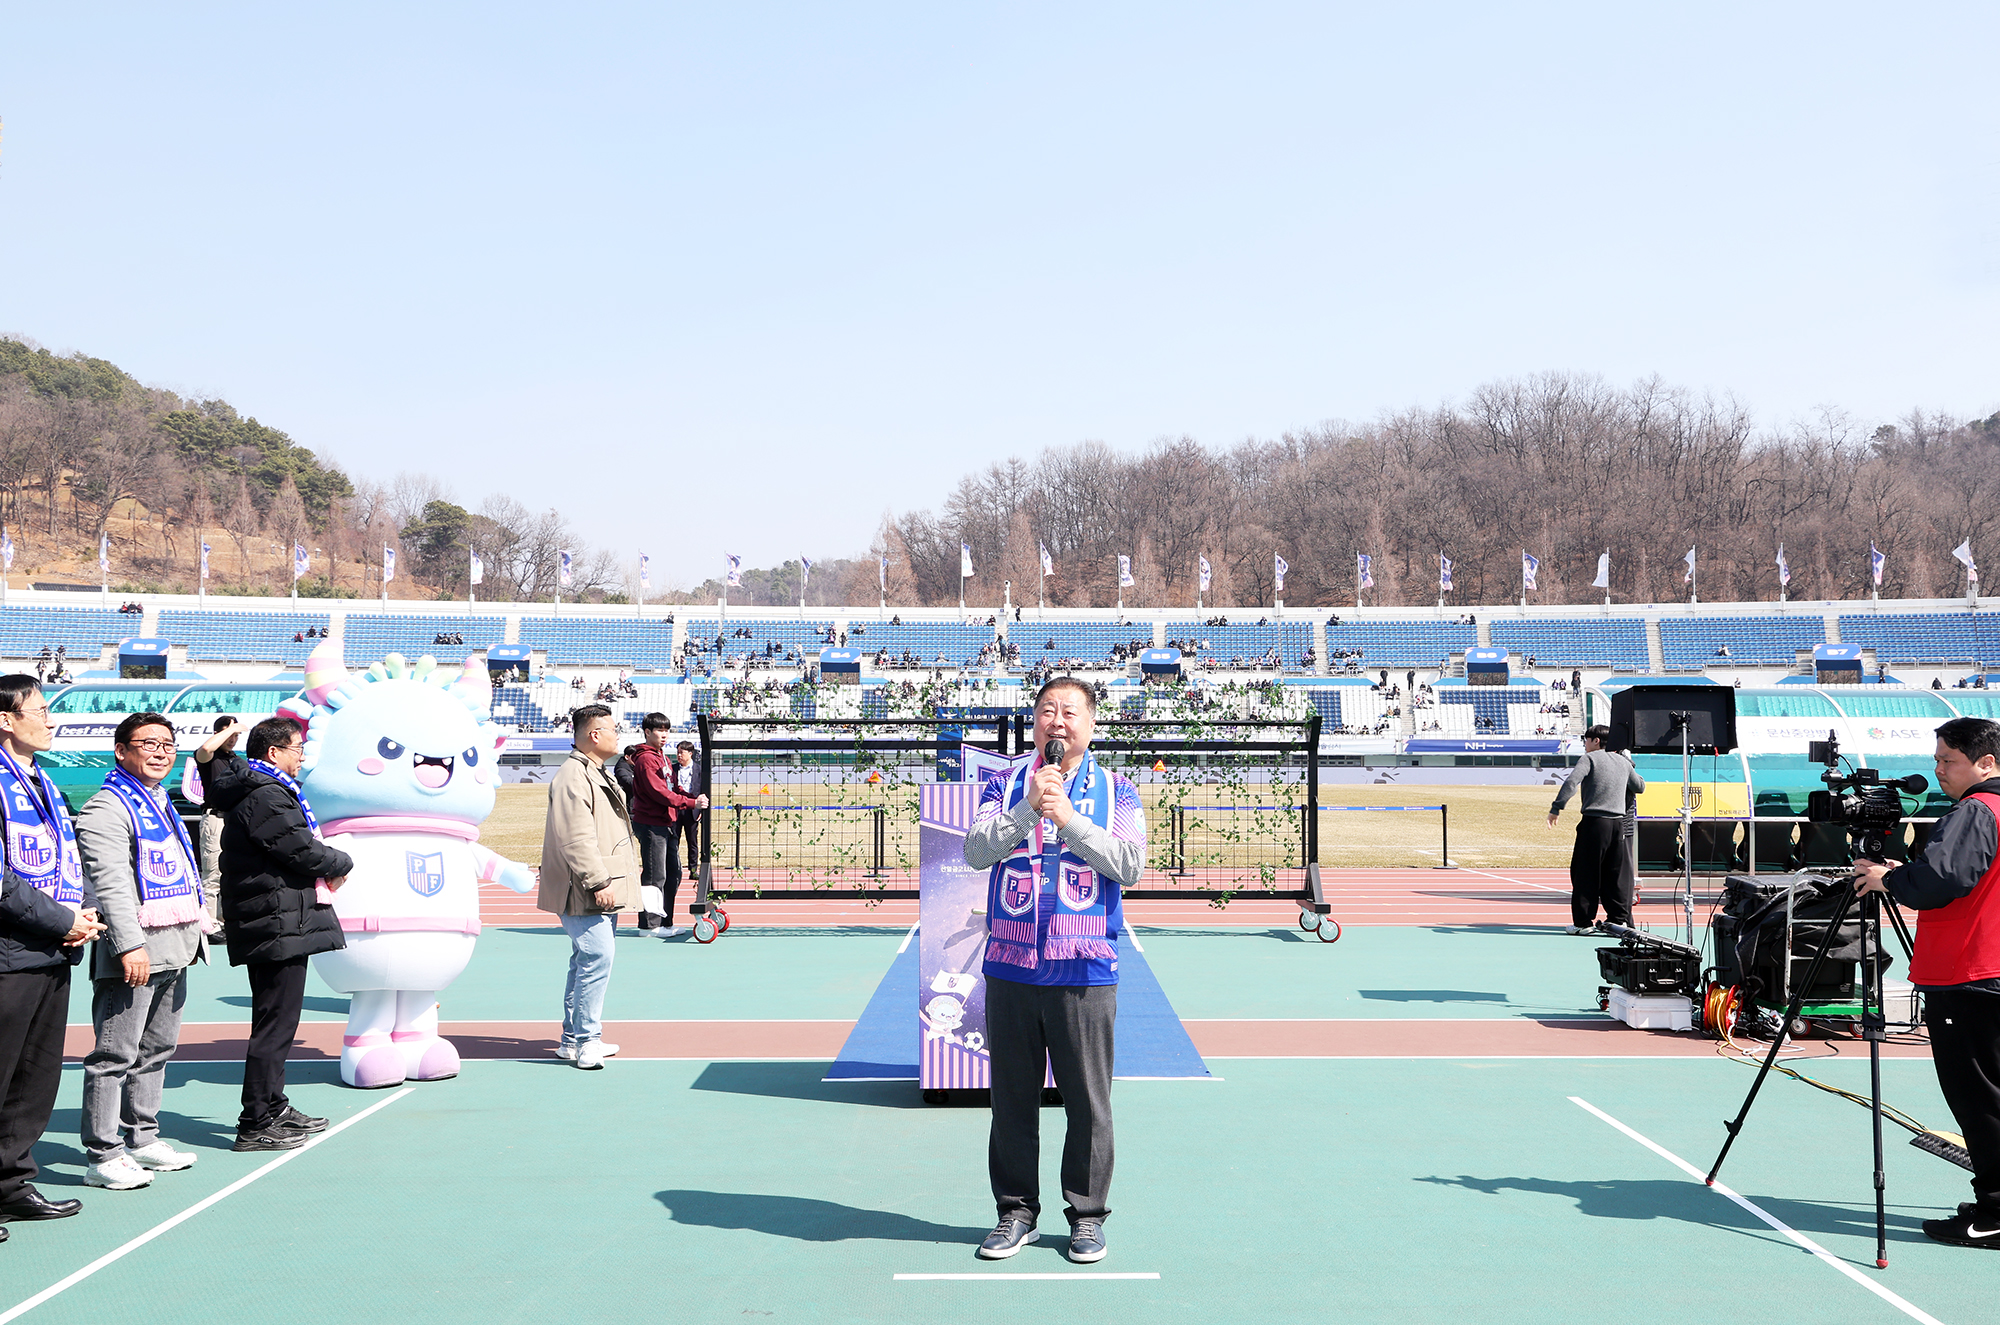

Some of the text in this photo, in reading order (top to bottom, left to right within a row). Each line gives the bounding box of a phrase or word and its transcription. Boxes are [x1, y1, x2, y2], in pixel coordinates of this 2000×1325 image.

[132, 643, 158, 651] B2
[1826, 648, 1849, 656] B7
[60, 726, 117, 736] best slee
[175, 726, 215, 735] KEL
[1890, 729, 1922, 739] ASE
[1464, 741, 1486, 750] NH
[152, 852, 176, 874] P F
[413, 858, 440, 889] P F
[1069, 873, 1089, 899] P F
[1009, 879, 1027, 905] P F
